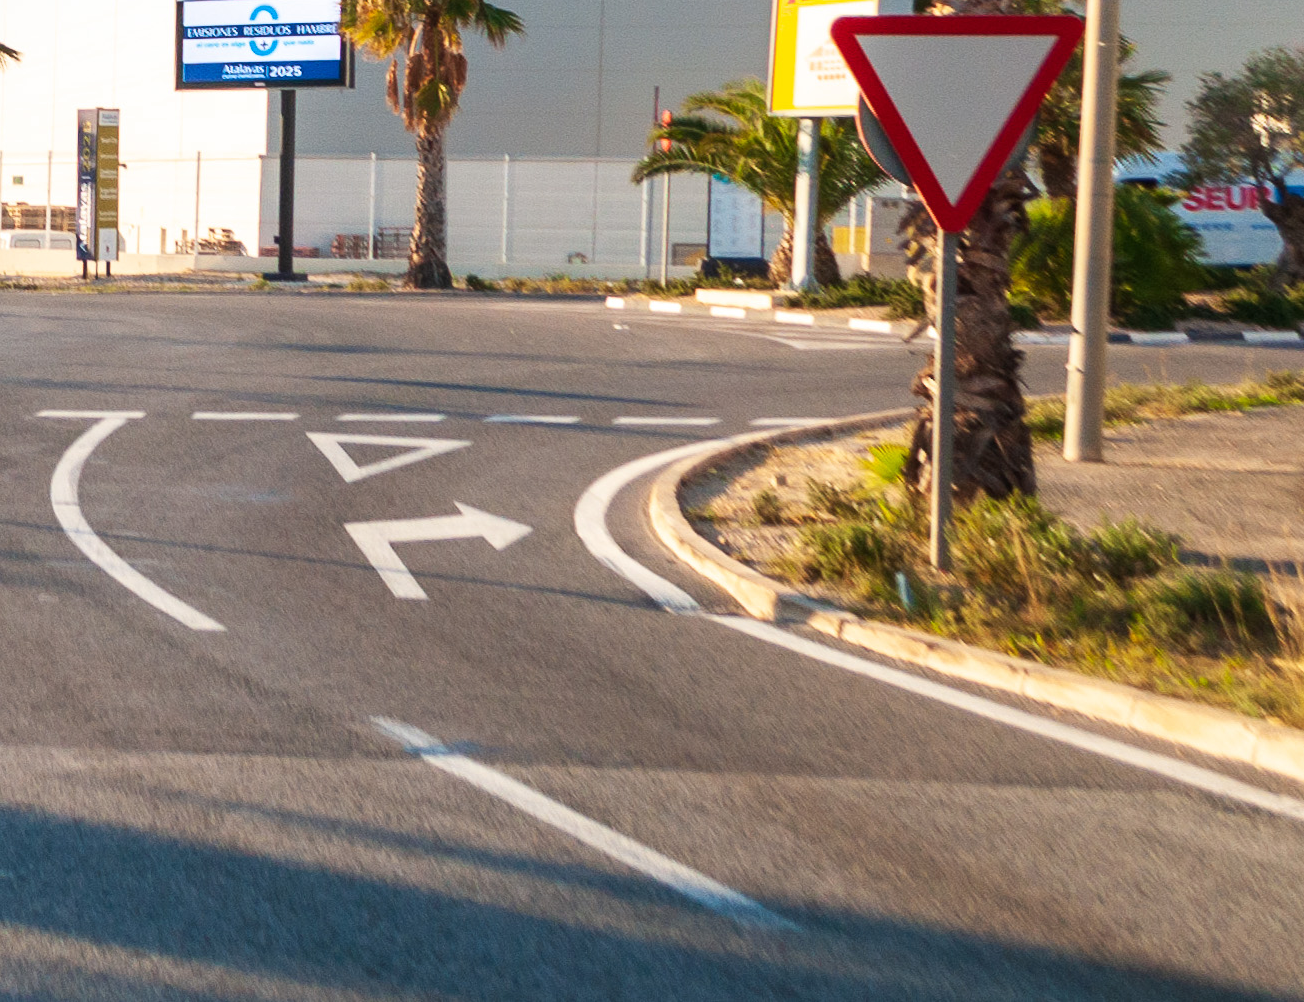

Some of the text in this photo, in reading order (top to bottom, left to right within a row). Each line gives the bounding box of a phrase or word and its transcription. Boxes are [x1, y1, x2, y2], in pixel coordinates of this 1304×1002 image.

[187, 23, 338, 38] EMISIONES RESIDUOS HAMBRE
[222, 63, 302, 77] Atalayas 2025
